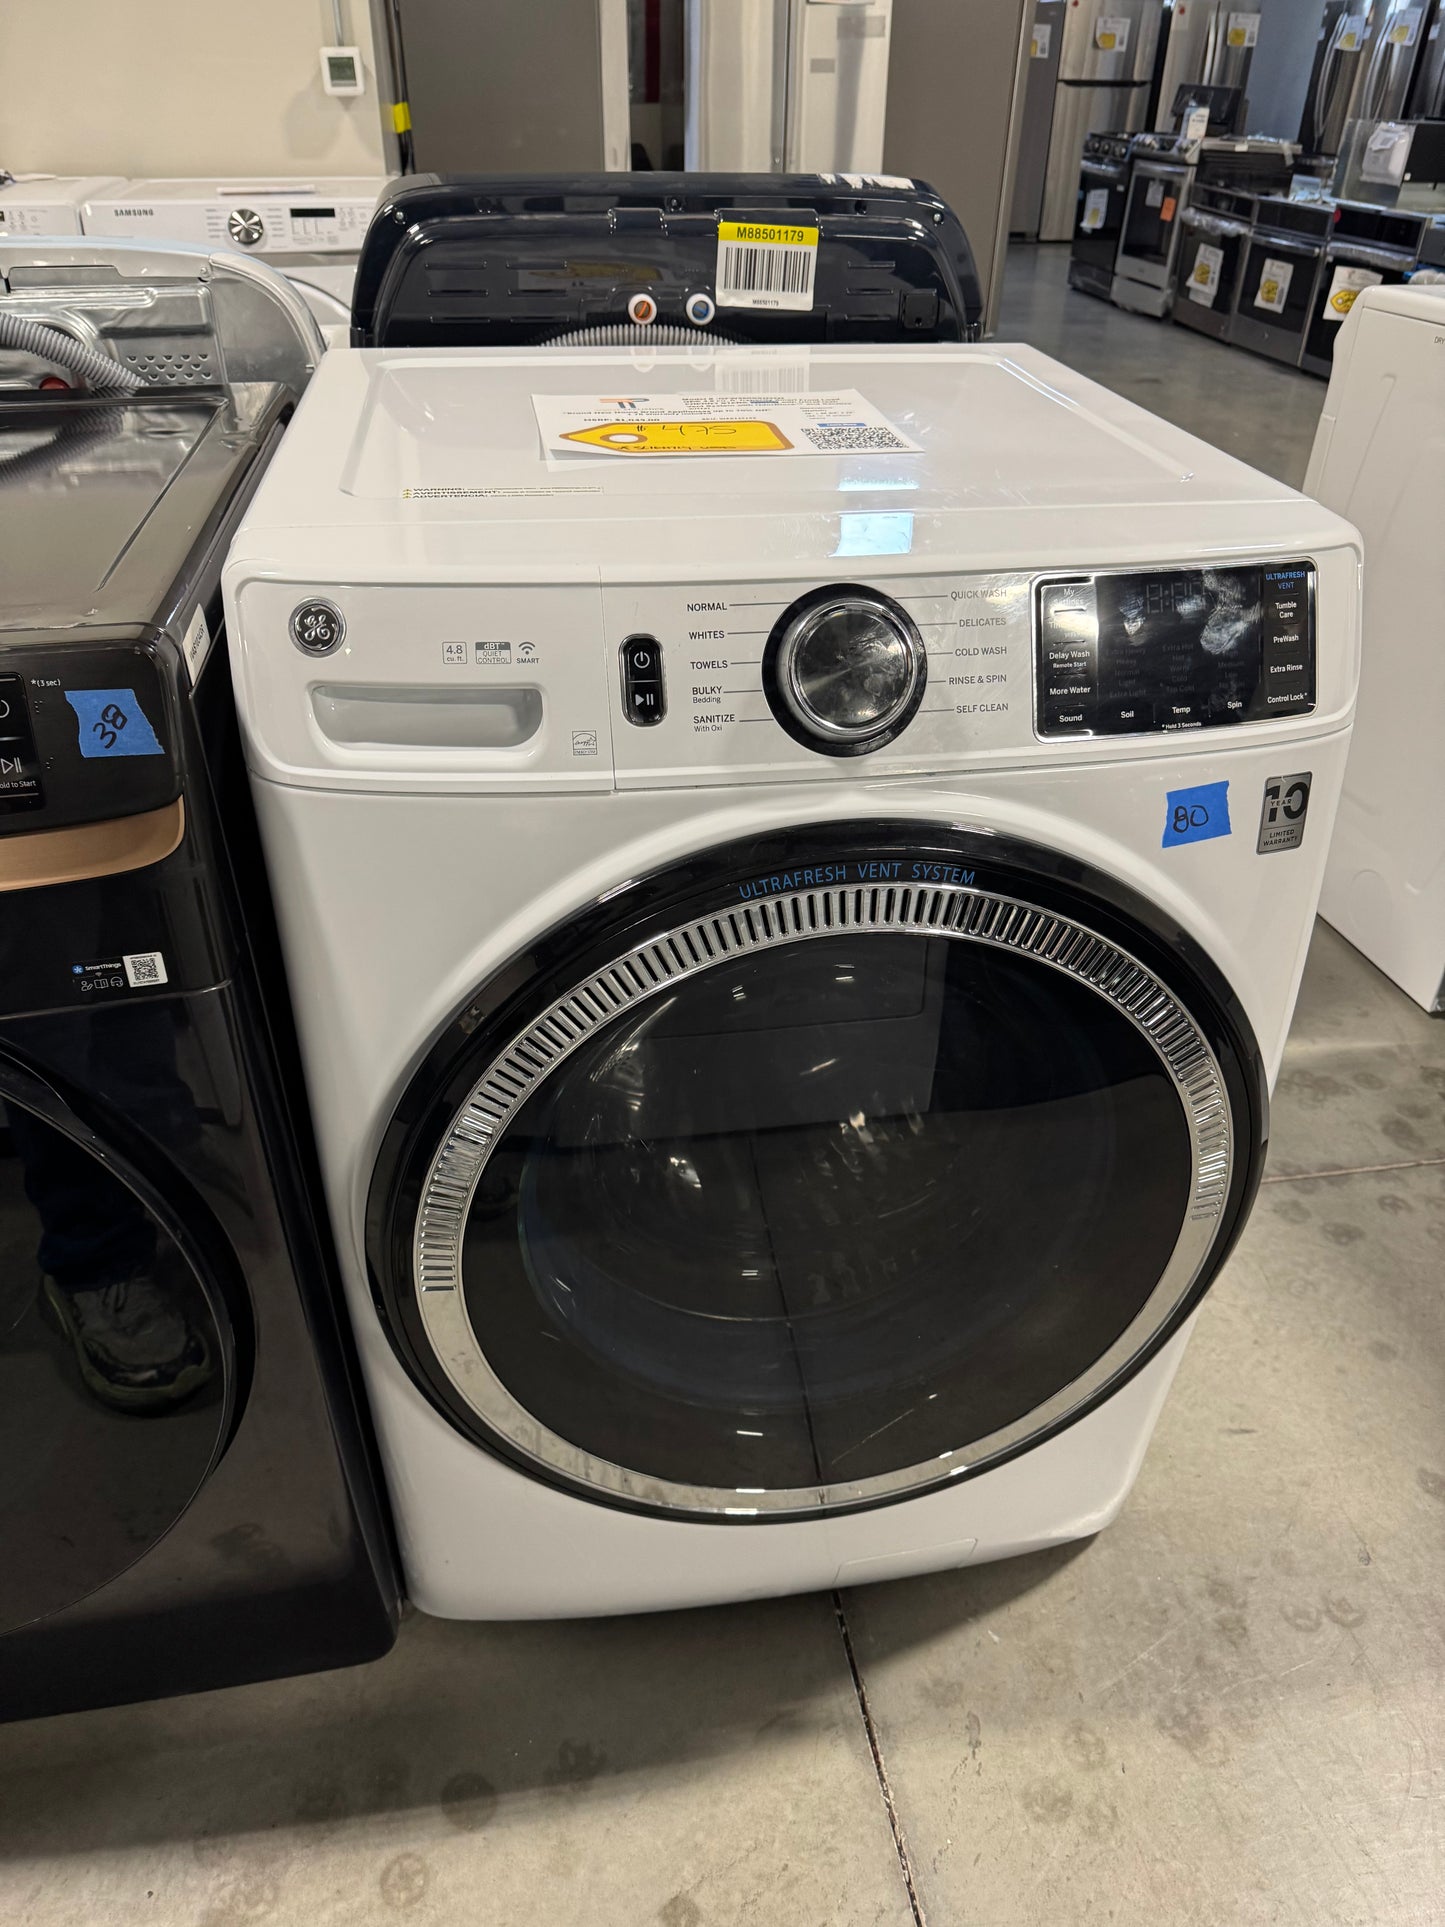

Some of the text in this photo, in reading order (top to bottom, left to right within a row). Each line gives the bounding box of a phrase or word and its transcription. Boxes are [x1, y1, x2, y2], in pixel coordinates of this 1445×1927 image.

[114, 208, 154, 217] SAMSUNG
[736, 226, 804, 242] M88501179
[1265, 570, 1306, 581] ULTRAFRESH
[1277, 581, 1295, 590] VENT
[950, 588, 1007, 601] QUICK WASH
[687, 602, 728, 612] NORMAL
[1275, 601, 1297, 610] Tumble
[1279, 610, 1294, 619] Care
[959, 617, 1007, 628] DELICATES
[689, 630, 725, 640] WHITES
[1273, 633, 1300, 644] PreWash
[446, 644, 463, 655] 4.8
[482, 650, 502, 658] QUIET
[954, 646, 1007, 657] COLD WASH
[1049, 650, 1091, 661] Delay Wash
[690, 660, 729, 670] TOWELS
[1270, 663, 1303, 674] Extra Rinse
[948, 674, 1007, 685] RINSE & SPIN
[692, 686, 722, 696] BULKY
[1049, 686, 1091, 696] More Water
[692, 696, 721, 705] Bedding
[1267, 694, 1289, 704] Control
[956, 703, 1009, 714] SELF CLEAN
[1172, 705, 1191, 714] Temp
[1227, 701, 1243, 710] Spin
[693, 714, 736, 724] SANITIZE
[1059, 714, 1083, 723] Sound
[1120, 710, 1135, 719] Soil
[694, 724, 723, 733] With Oxi
[1265, 781, 1310, 823] 10
[1270, 798, 1292, 807] YEAR
[1172, 805, 1209, 834] 80
[1269, 829, 1295, 839] LIMITED
[1263, 835, 1298, 847] WARRANTY
[738, 862, 976, 900] ULTRAFRESH VENT SYSTEM
[85, 962, 122, 971] SmartThings
